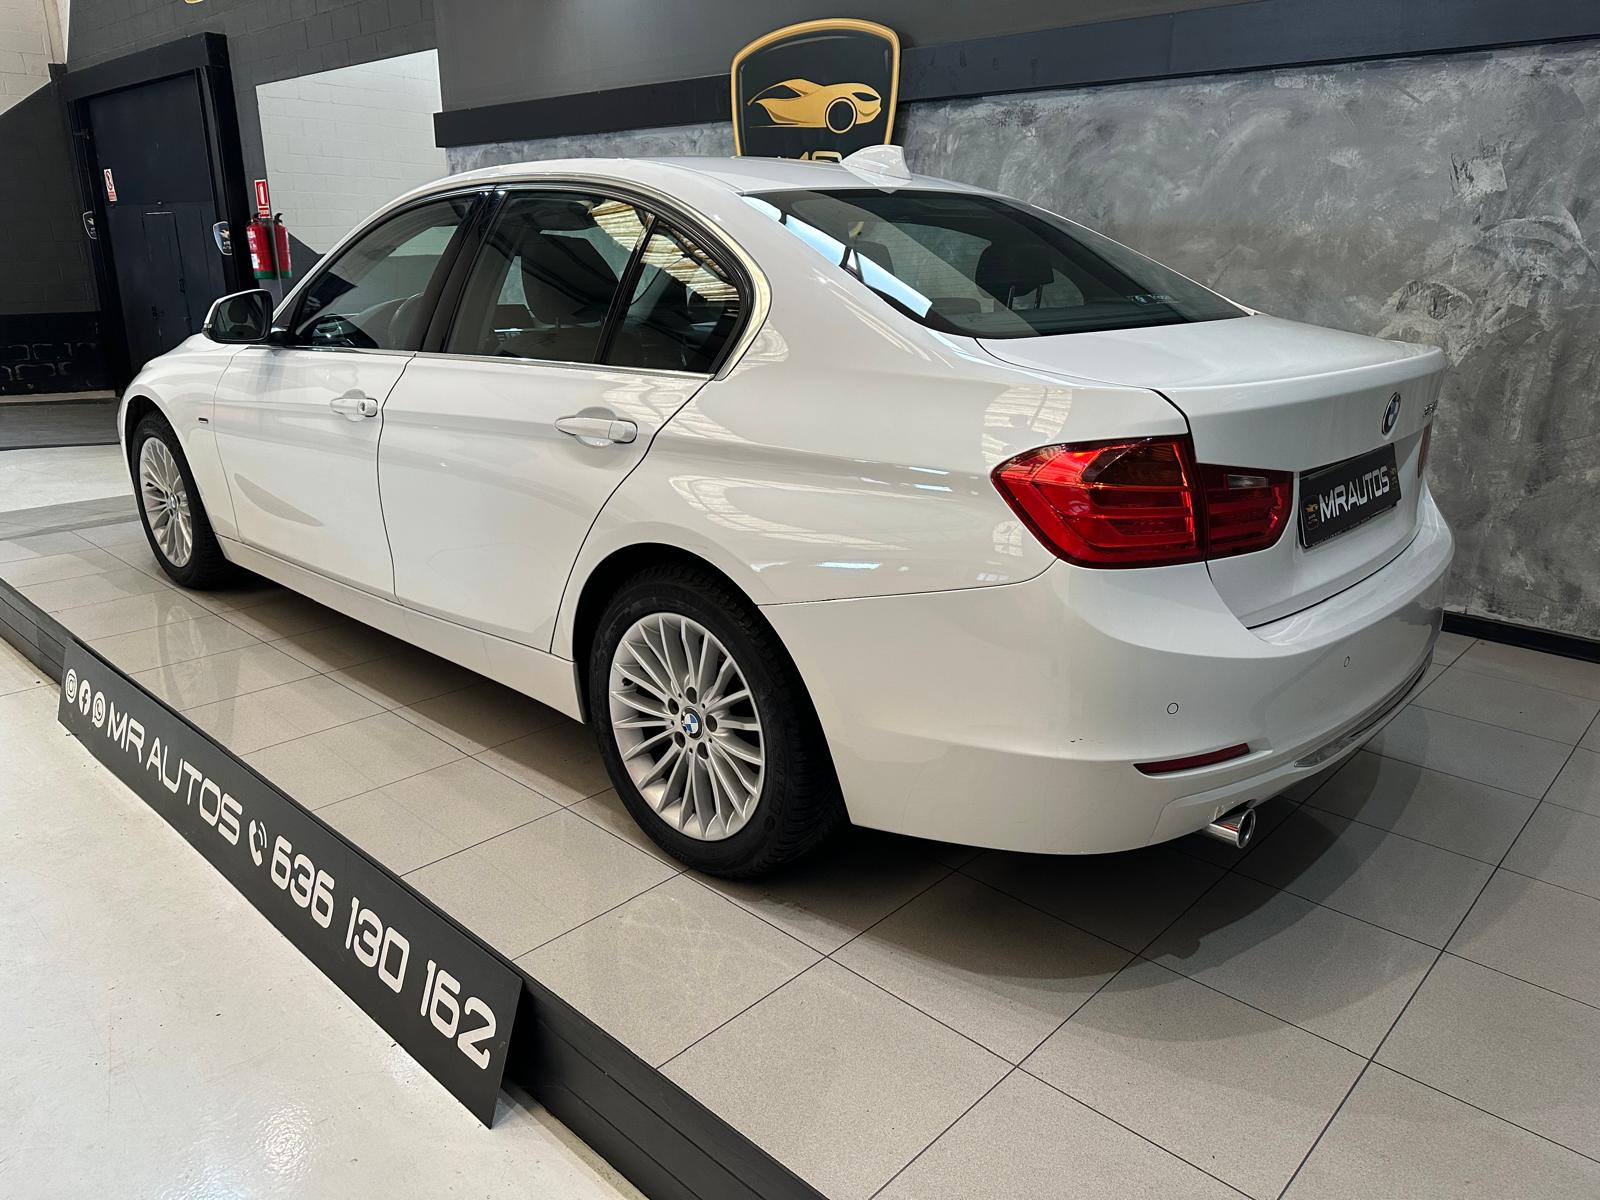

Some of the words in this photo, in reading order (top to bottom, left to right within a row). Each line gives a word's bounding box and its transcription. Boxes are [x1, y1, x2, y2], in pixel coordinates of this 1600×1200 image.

[106, 701, 146, 763] MR
[146, 737, 243, 846] AUTOS
[270, 835, 335, 929] 636
[345, 896, 410, 994] 130
[420, 959, 497, 1070] 162
